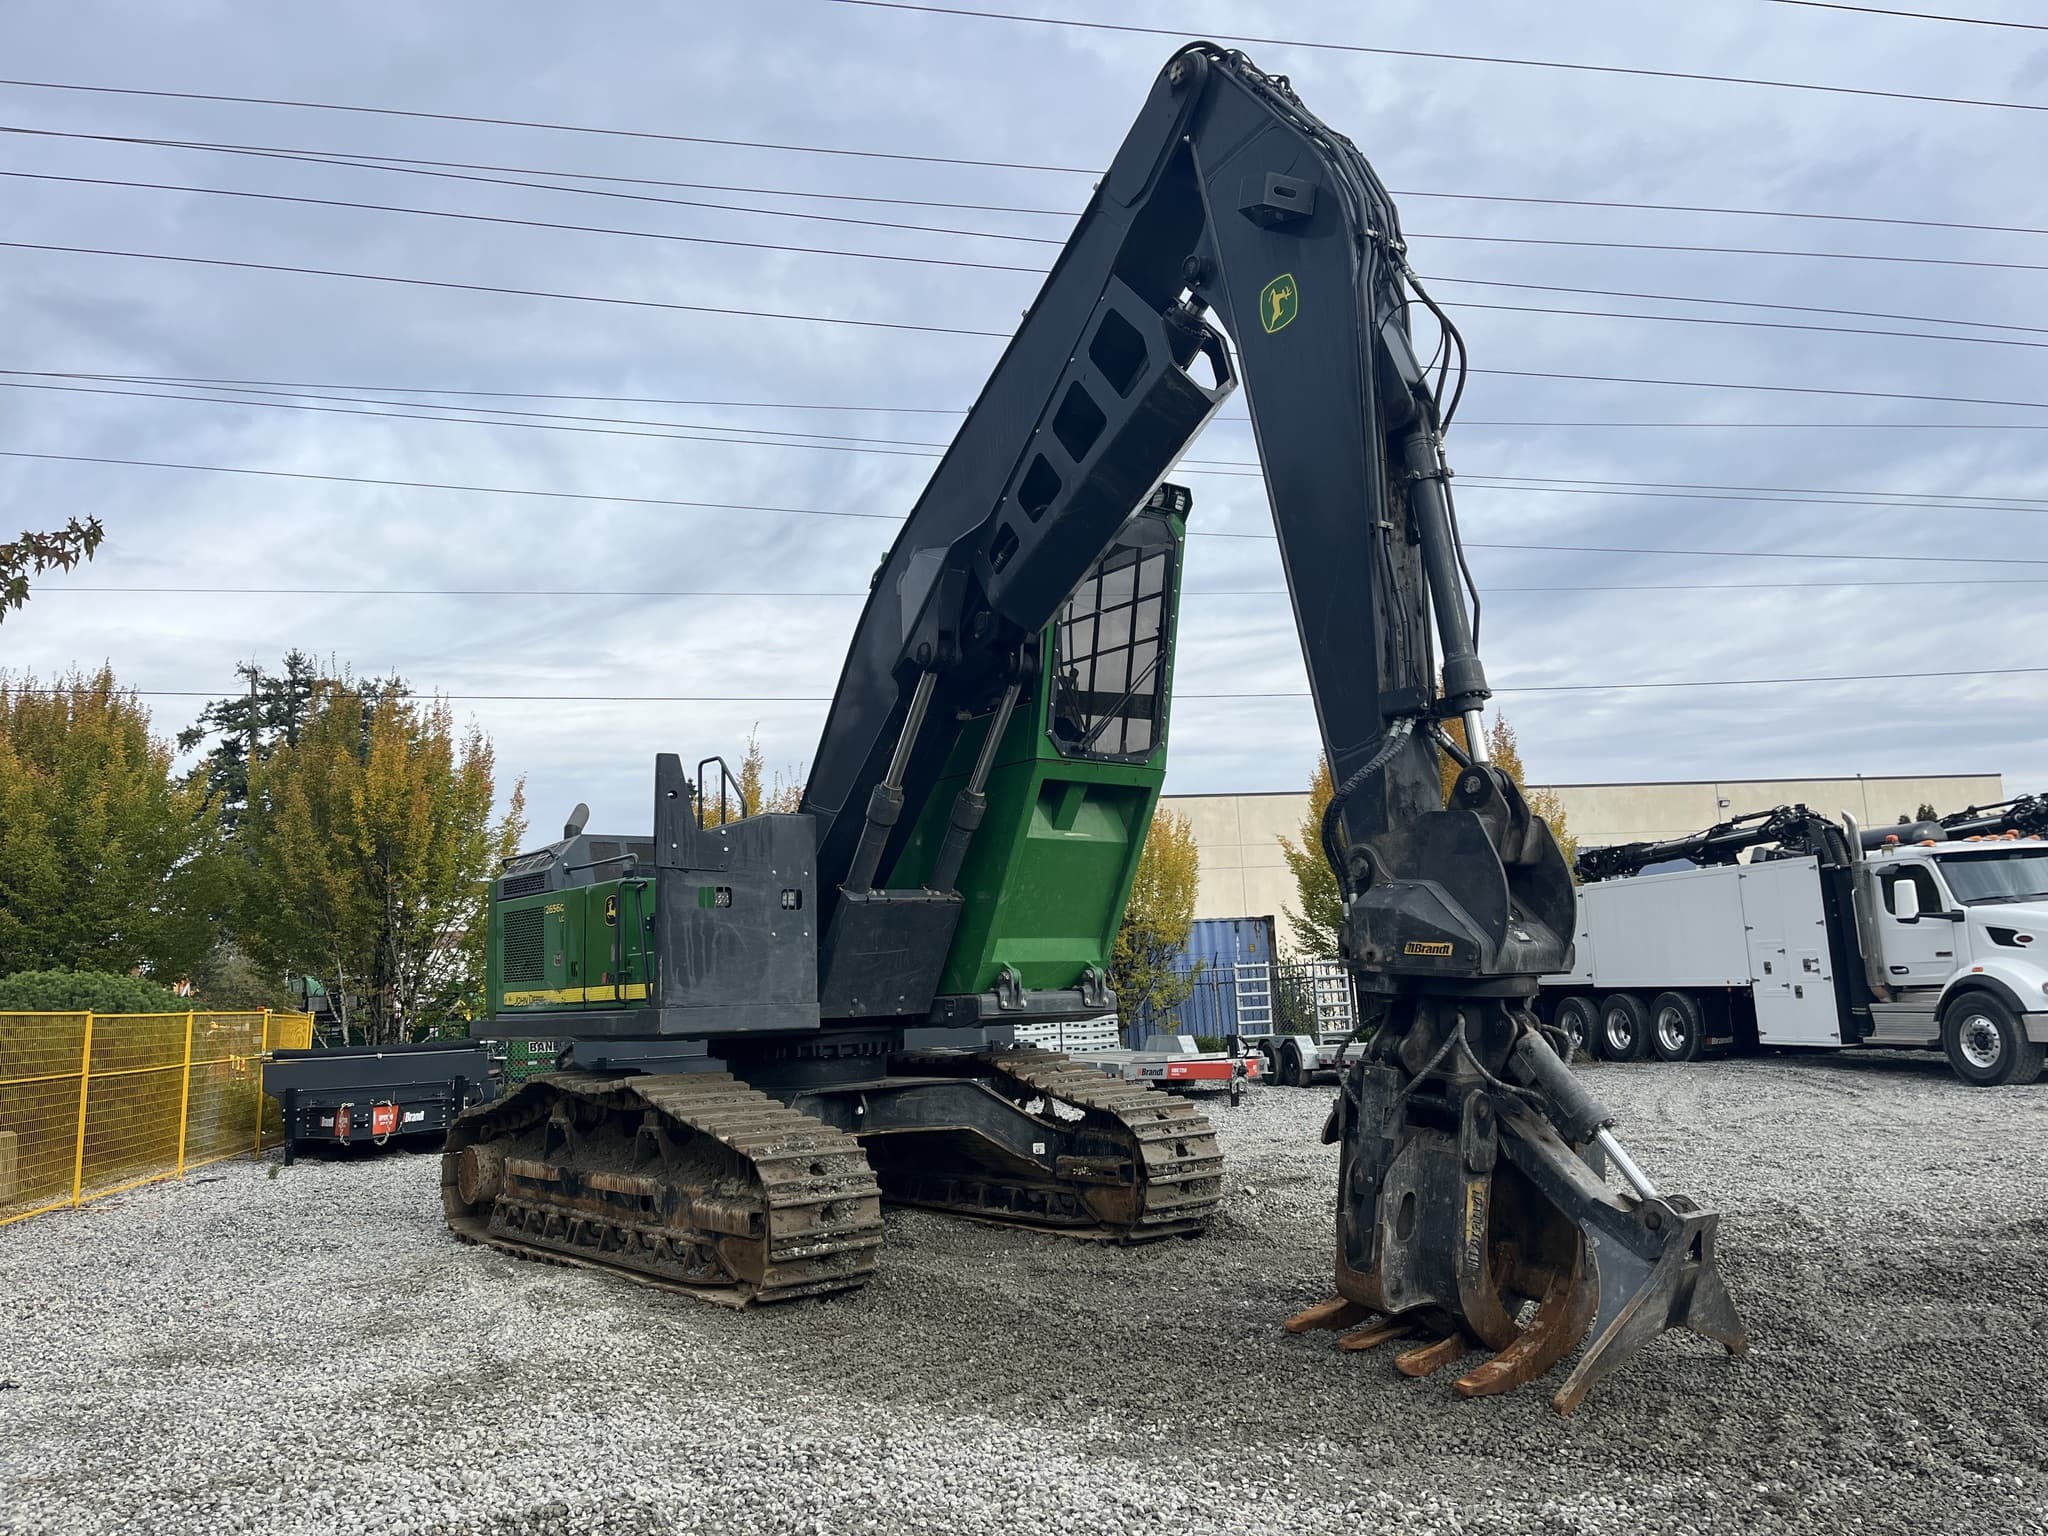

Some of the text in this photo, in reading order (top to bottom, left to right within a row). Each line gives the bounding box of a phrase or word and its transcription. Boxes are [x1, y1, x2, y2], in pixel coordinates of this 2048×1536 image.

[1413, 943, 1450, 955] Brandt
[528, 1041, 558, 1053] BAN
[1141, 1067, 1164, 1077] Brandt
